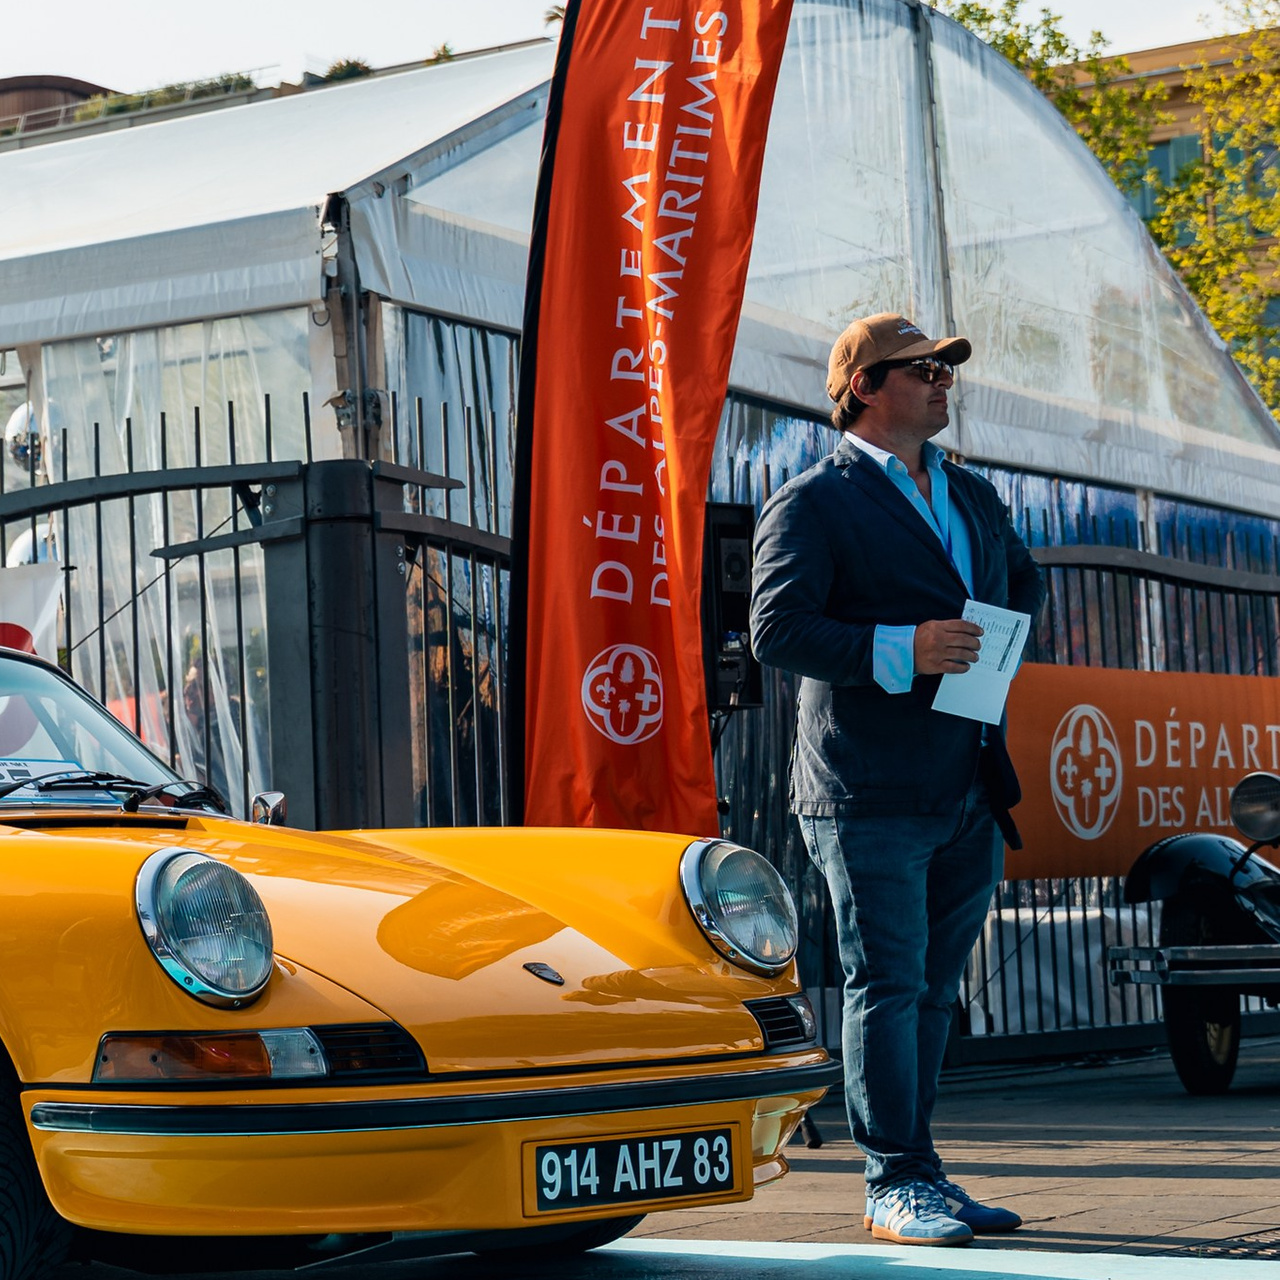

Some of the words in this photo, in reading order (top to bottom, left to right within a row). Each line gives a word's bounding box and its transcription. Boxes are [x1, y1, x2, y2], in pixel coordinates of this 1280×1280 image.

[582, 6, 681, 605] DÉPARTEMENT
[1136, 786, 1186, 828] DES
[1194, 786, 1234, 827] AL
[541, 1147, 600, 1200] 914
[613, 1139, 683, 1193] AHZ
[693, 1135, 730, 1184] 83
